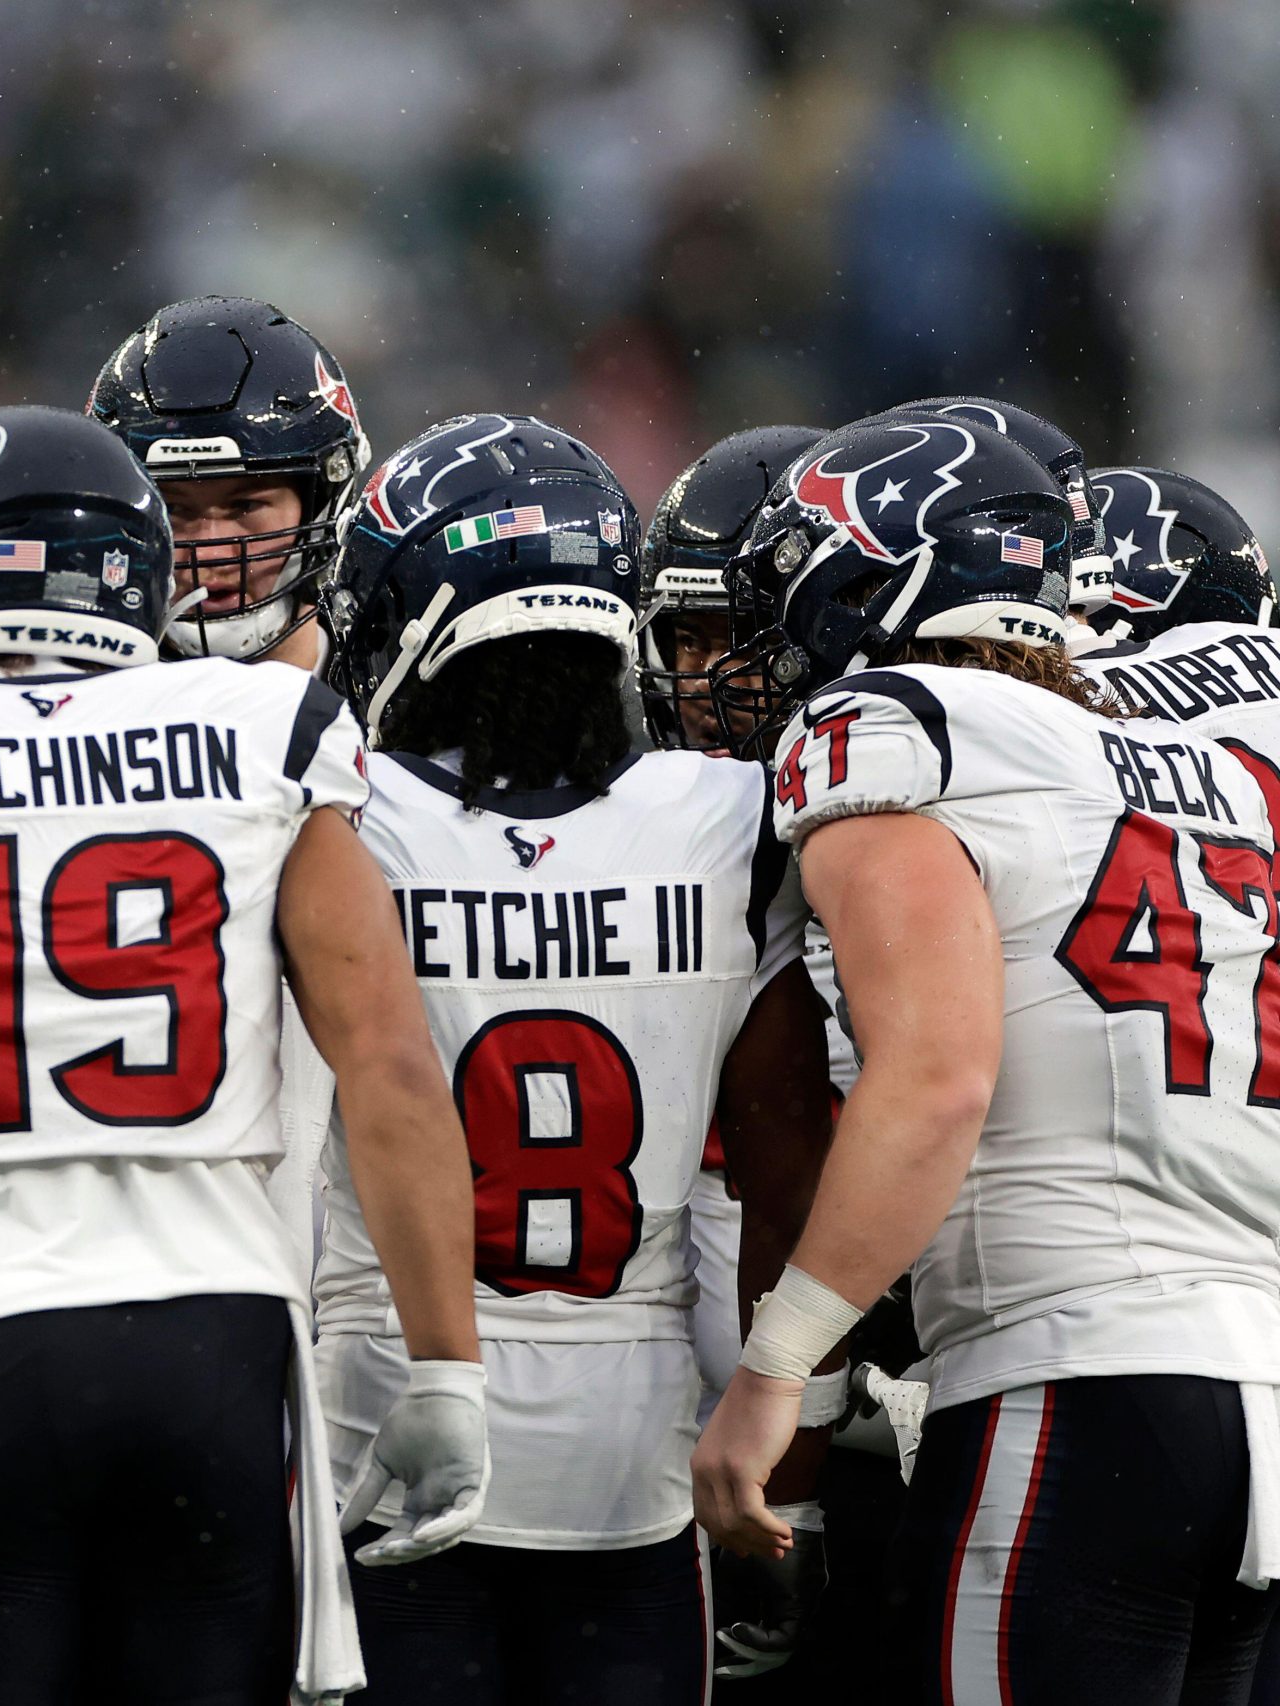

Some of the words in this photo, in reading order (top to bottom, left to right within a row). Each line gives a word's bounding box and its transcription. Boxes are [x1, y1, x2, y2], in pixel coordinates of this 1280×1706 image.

[160, 445, 222, 453] TEXANS
[518, 594, 620, 614] TEXANS
[665, 575, 718, 584] TEXANS
[0, 625, 137, 656] TEXANS
[777, 707, 861, 815] 47
[1098, 730, 1238, 825] BECK
[392, 888, 631, 979] ETCHIE
[655, 884, 703, 973] III
[1054, 803, 1280, 1109] 47
[453, 1009, 644, 1299] 8
